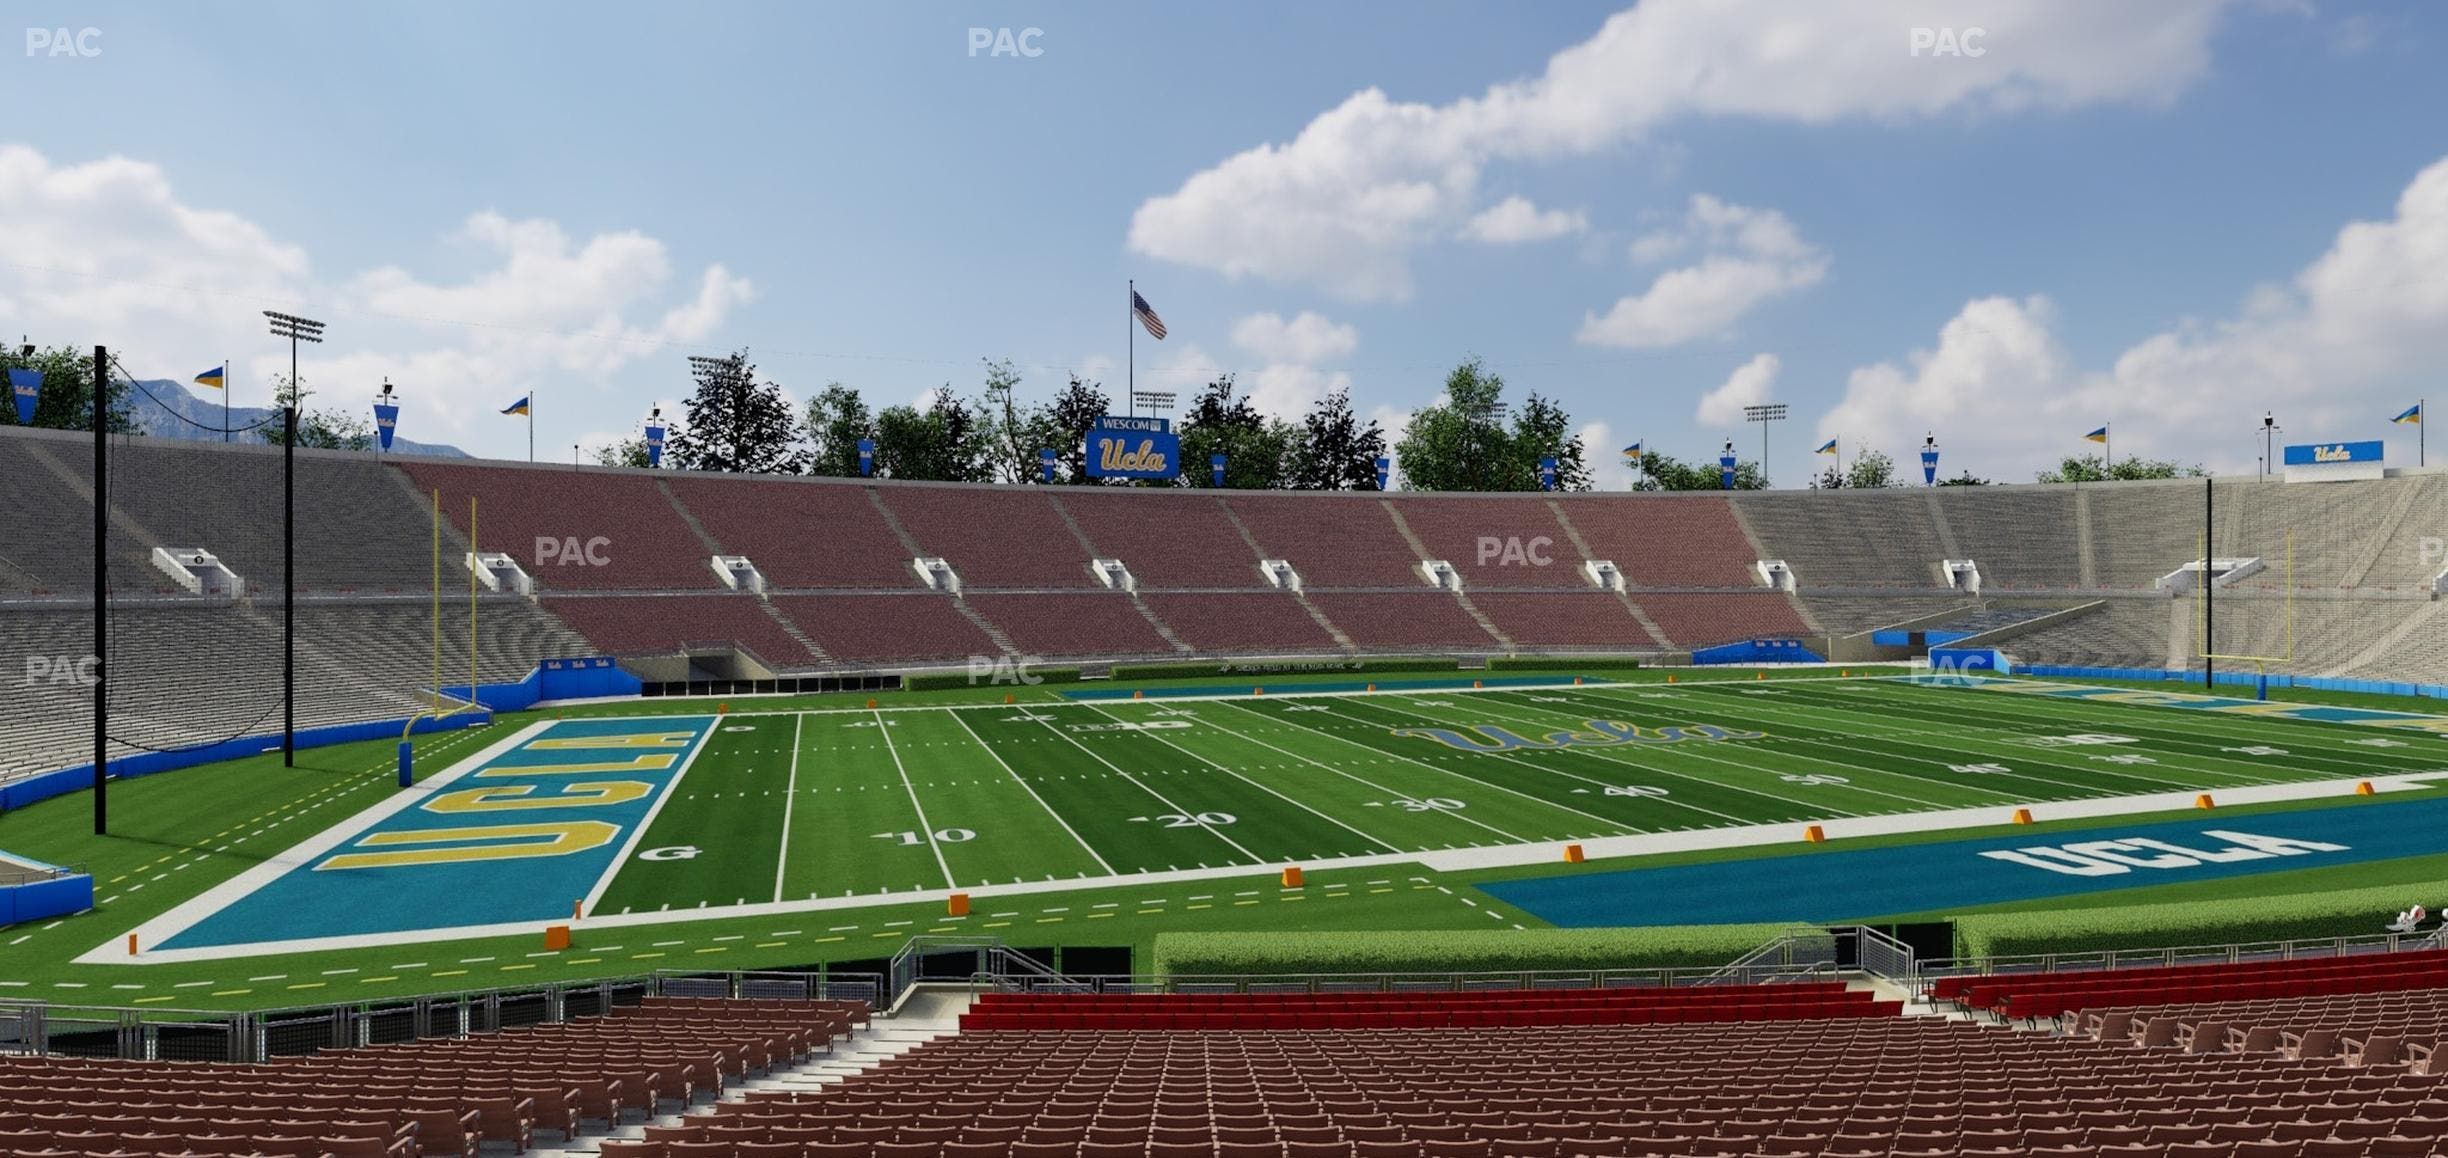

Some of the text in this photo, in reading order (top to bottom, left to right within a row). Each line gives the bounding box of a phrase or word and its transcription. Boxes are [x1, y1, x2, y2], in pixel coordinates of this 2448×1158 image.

[1103, 418, 1149, 430] WESCOM
[1604, 785, 1669, 797] 40
[312, 731, 697, 871] UCLA
[1391, 798, 1466, 812] 30
[1156, 812, 1237, 828] 20
[893, 828, 977, 846] 10
[639, 845, 703, 861] G
[1977, 830, 2353, 877] UCLA
